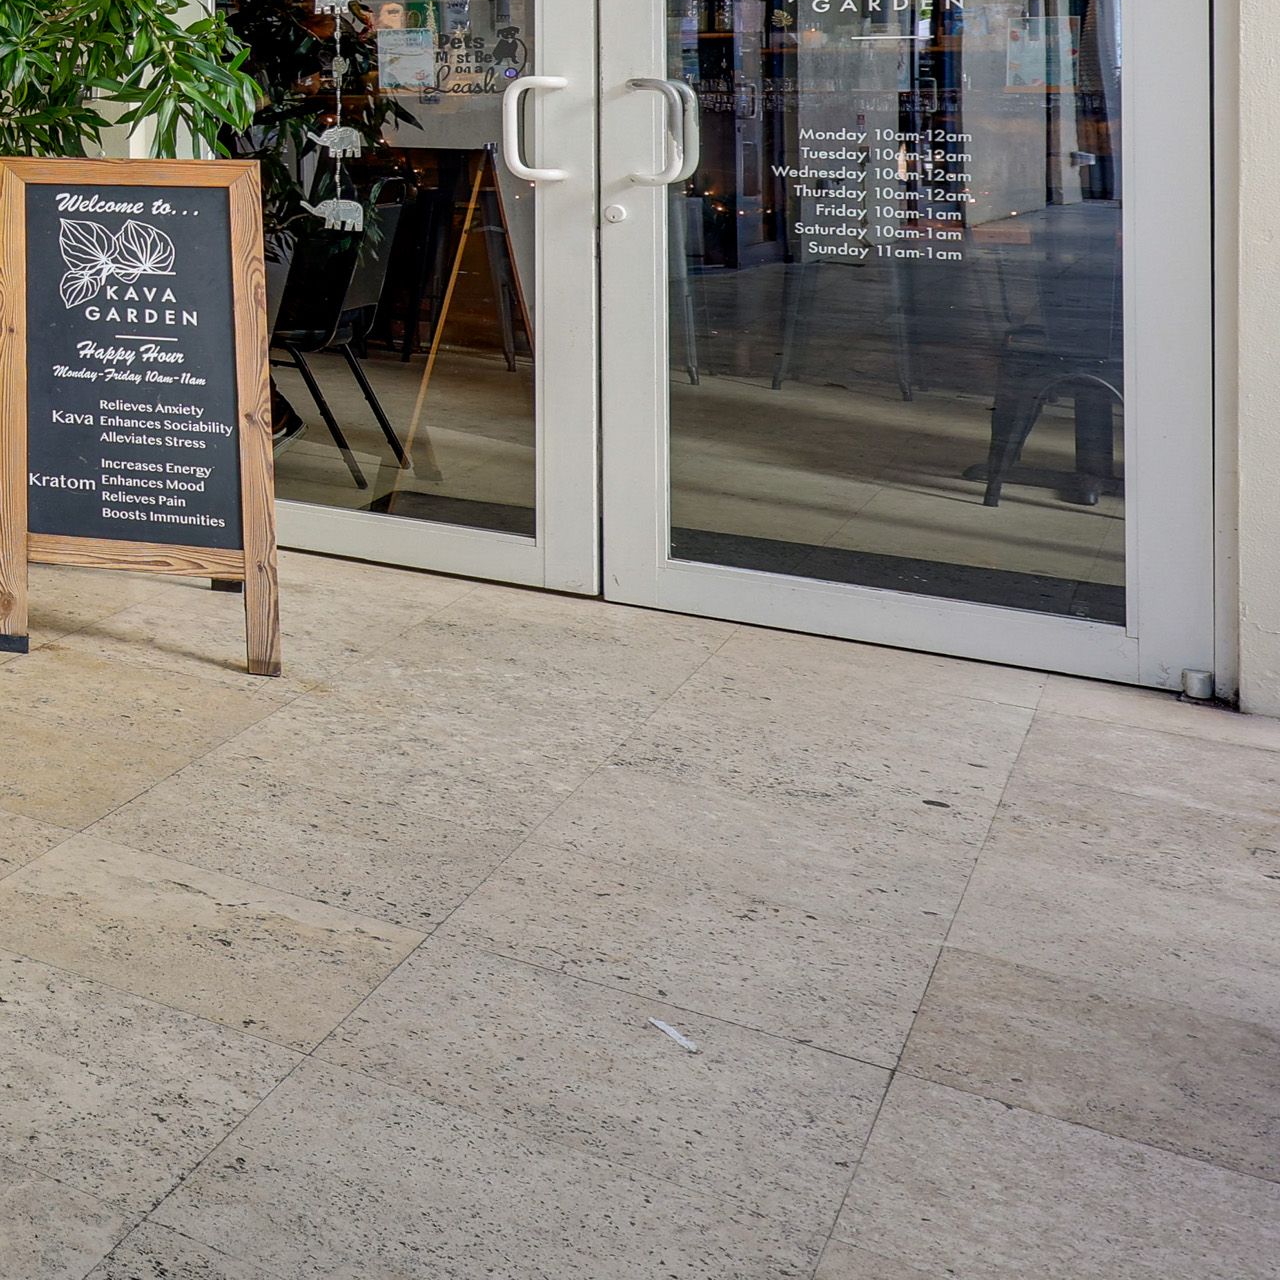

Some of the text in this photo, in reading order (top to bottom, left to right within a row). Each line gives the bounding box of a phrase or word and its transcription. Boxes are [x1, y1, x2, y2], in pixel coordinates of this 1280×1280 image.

[437, 33, 485, 49] Pets
[435, 51, 493, 64] Mst Be
[475, 66, 483, 74] a
[424, 65, 500, 94] Leash
[799, 128, 972, 144] Monday 10am-12am
[801, 147, 972, 163] Tuesday 10am-12am
[771, 165, 972, 182] Wednesday 10am-12am
[793, 185, 972, 202] Thursday 10am-12am
[55, 193, 144, 214] Welcome
[816, 204, 962, 221] Friday 10am-1am
[794, 223, 962, 240] Saturday 10am-1am
[808, 242, 962, 260] Sunday 11am-1am
[106, 285, 177, 303] KAVA
[85, 306, 199, 327] GARDEN
[76, 340, 185, 366] Happy Hour
[52, 365, 207, 386] Monday-Friday 10am-11am
[52, 410, 94, 425] Kava
[100, 399, 205, 418] Relieves Anxiety
[100, 416, 233, 437] Enhances Sociability
[100, 432, 206, 449] Alleviates Stress
[101, 458, 212, 478] Increases Energy
[29, 472, 96, 491] Kratom
[101, 474, 205, 492] Enhances Mood
[102, 491, 186, 507] Relieves Pain
[102, 508, 225, 527] Boosts Immunities
